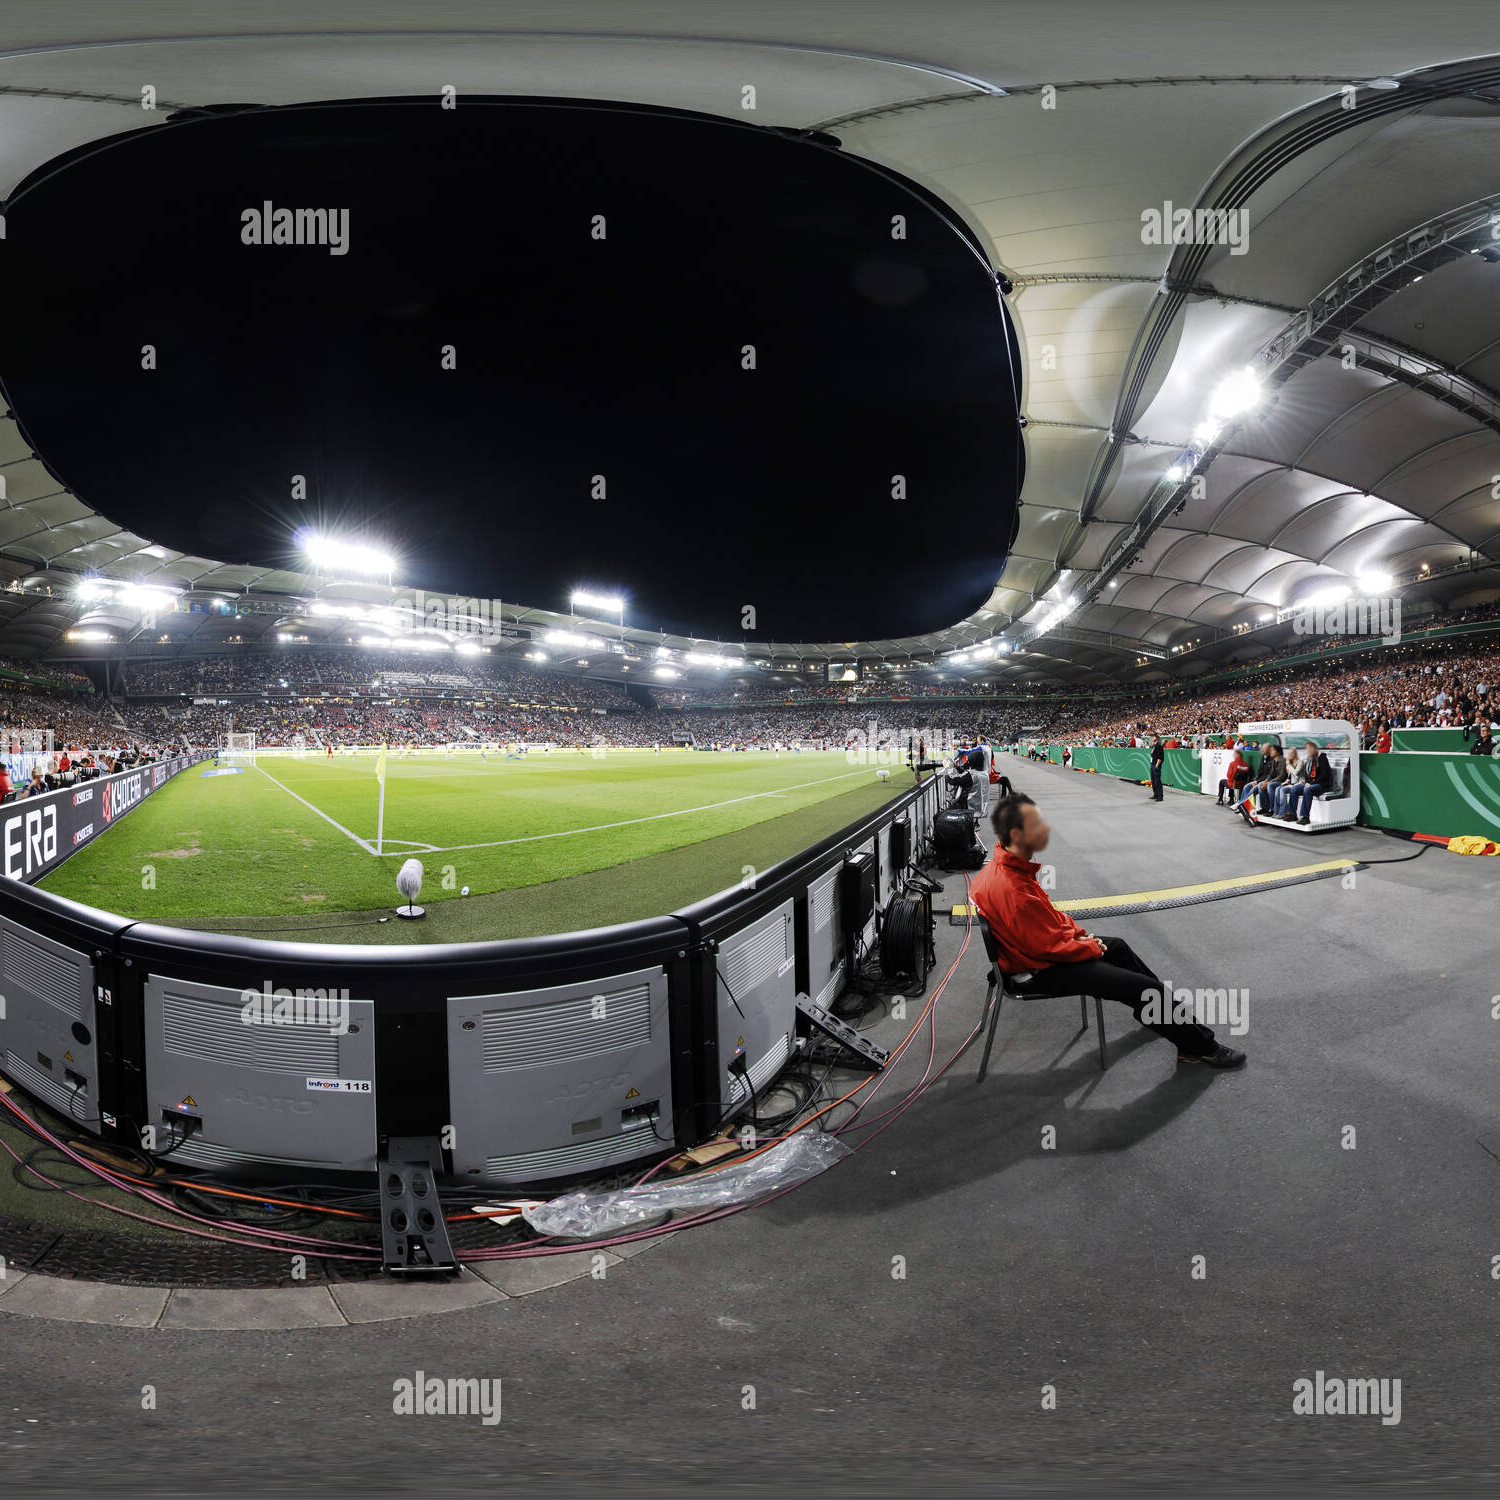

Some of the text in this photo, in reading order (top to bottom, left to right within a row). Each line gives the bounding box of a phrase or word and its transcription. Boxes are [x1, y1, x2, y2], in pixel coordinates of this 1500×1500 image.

[1213, 753, 1222, 765] 55
[111, 774, 141, 818] KYOCERA
[308, 1080, 370, 1091] infront 118
